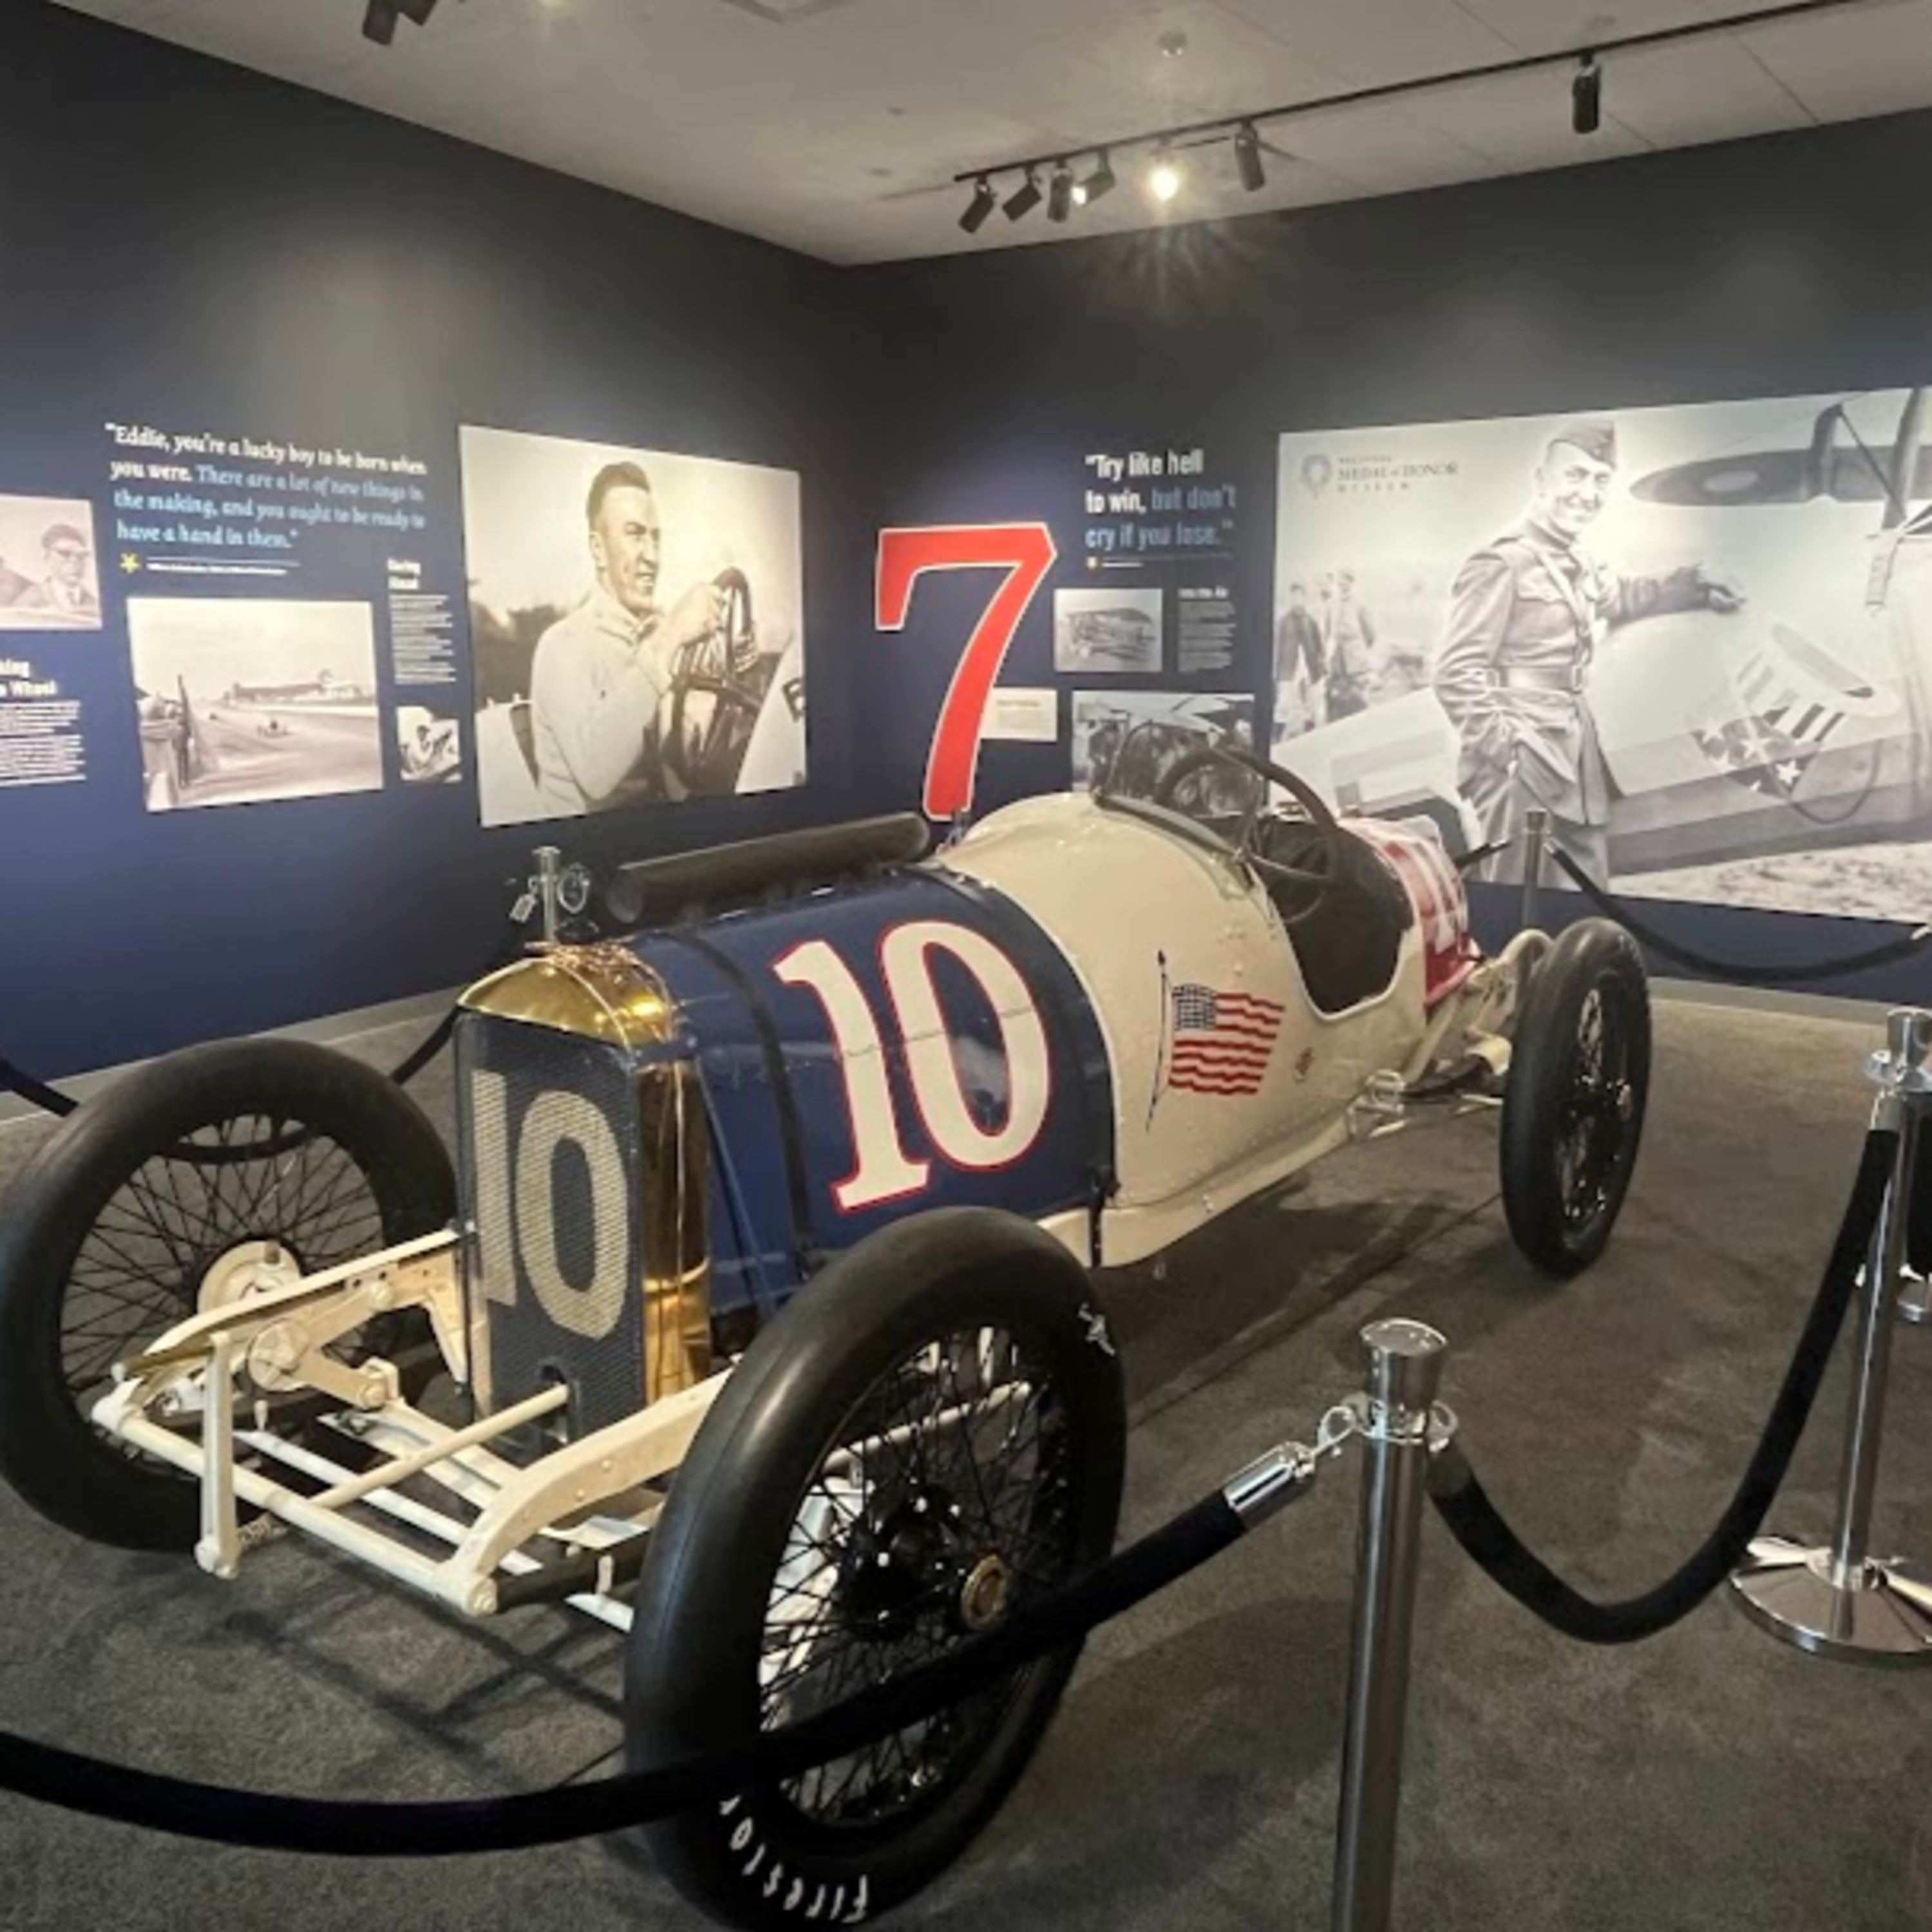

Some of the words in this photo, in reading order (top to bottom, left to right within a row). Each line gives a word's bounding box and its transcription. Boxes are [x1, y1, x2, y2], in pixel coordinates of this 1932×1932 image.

[229, 442, 240, 455] a
[242, 437, 285, 465] lucky
[288, 442, 316, 468] boy
[318, 449, 332, 466] to
[335, 448, 352, 467] be
[355, 452, 388, 471] born
[390, 455, 427, 474] when
[1129, 451, 1162, 476] like
[1167, 448, 1204, 475] hell
[109, 461, 144, 481] you
[147, 464, 193, 482] were.
[196, 464, 243, 486] There
[246, 473, 273, 489] are
[276, 477, 287, 490] a
[289, 471, 309, 492] lot
[312, 477, 329, 498] of
[330, 480, 359, 495] new
[363, 480, 405, 504] things
[410, 484, 424, 502] in
[1085, 489, 1105, 513] to
[1108, 487, 1146, 515] win,
[1151, 486, 1182, 511] but
[114, 488, 144, 510] the
[147, 492, 218, 519] making,
[222, 497, 254, 516] and
[256, 505, 284, 522] you
[289, 502, 331, 526] ought
[334, 507, 348, 523] to
[352, 506, 368, 525] be
[372, 509, 408, 533] ready
[412, 514, 426, 529] to
[117, 518, 160, 542] have
[162, 527, 175, 542] a
[178, 523, 223, 545] hand
[226, 528, 243, 545] in
[1085, 527, 1115, 552] cry
[1119, 522, 1134, 547] if
[1138, 526, 1170, 552] you
[875, 522, 1057, 820] 7
[773, 920, 1051, 1213] 10
[471, 1069, 630, 1340] 10
